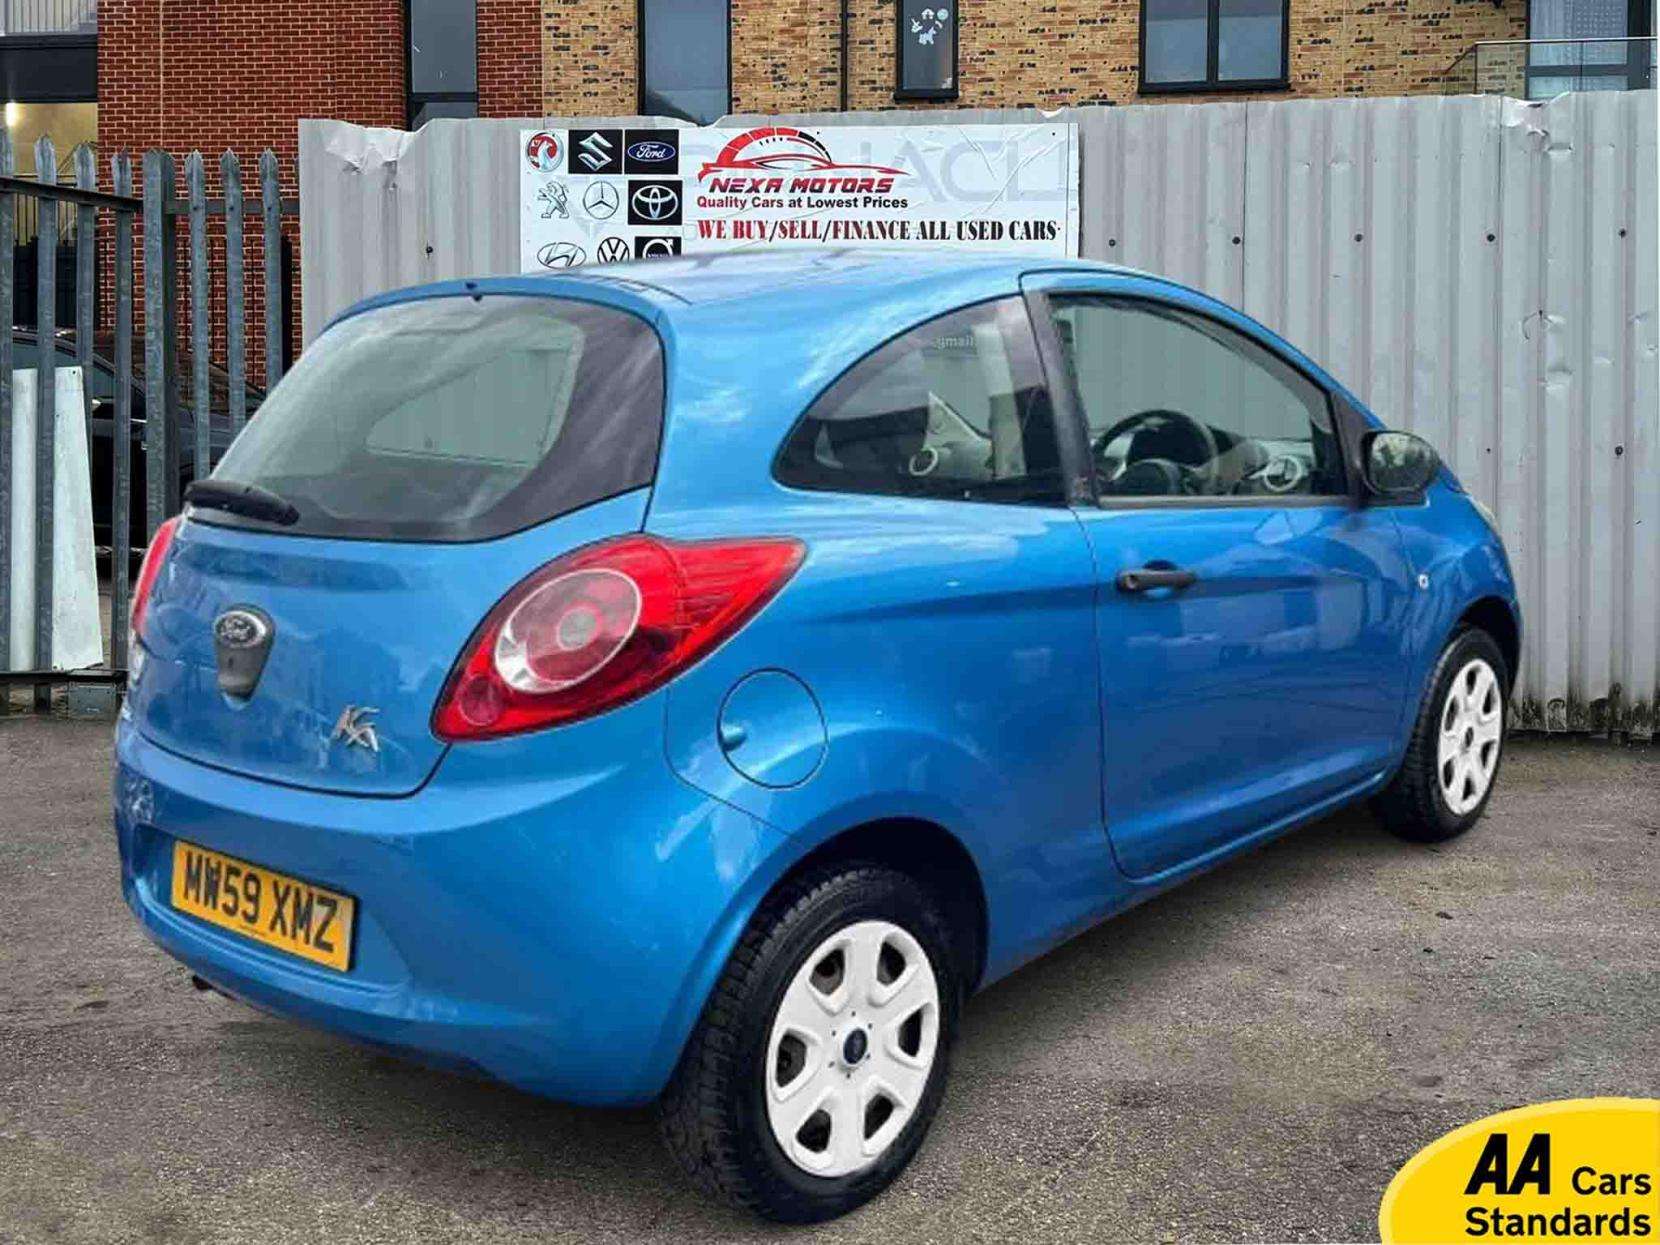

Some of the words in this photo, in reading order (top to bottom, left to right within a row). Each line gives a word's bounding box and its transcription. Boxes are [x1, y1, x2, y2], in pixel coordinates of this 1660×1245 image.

[636, 144, 666, 159] Ford
[709, 177, 783, 193] NEXA
[790, 177, 894, 193] MOTORS
[697, 195, 747, 210] Quality
[752, 196, 784, 208] Cars
[788, 197, 802, 208] at
[807, 196, 859, 208] Lowest
[863, 196, 908, 208] Prices
[697, 220, 727, 240] WE
[733, 220, 910, 242] BUY/SELL/FINANCE
[916, 220, 950, 240] ALL
[956, 220, 1003, 240] USED
[184, 850, 263, 925] MW59
[268, 880, 339, 954] XMZ
